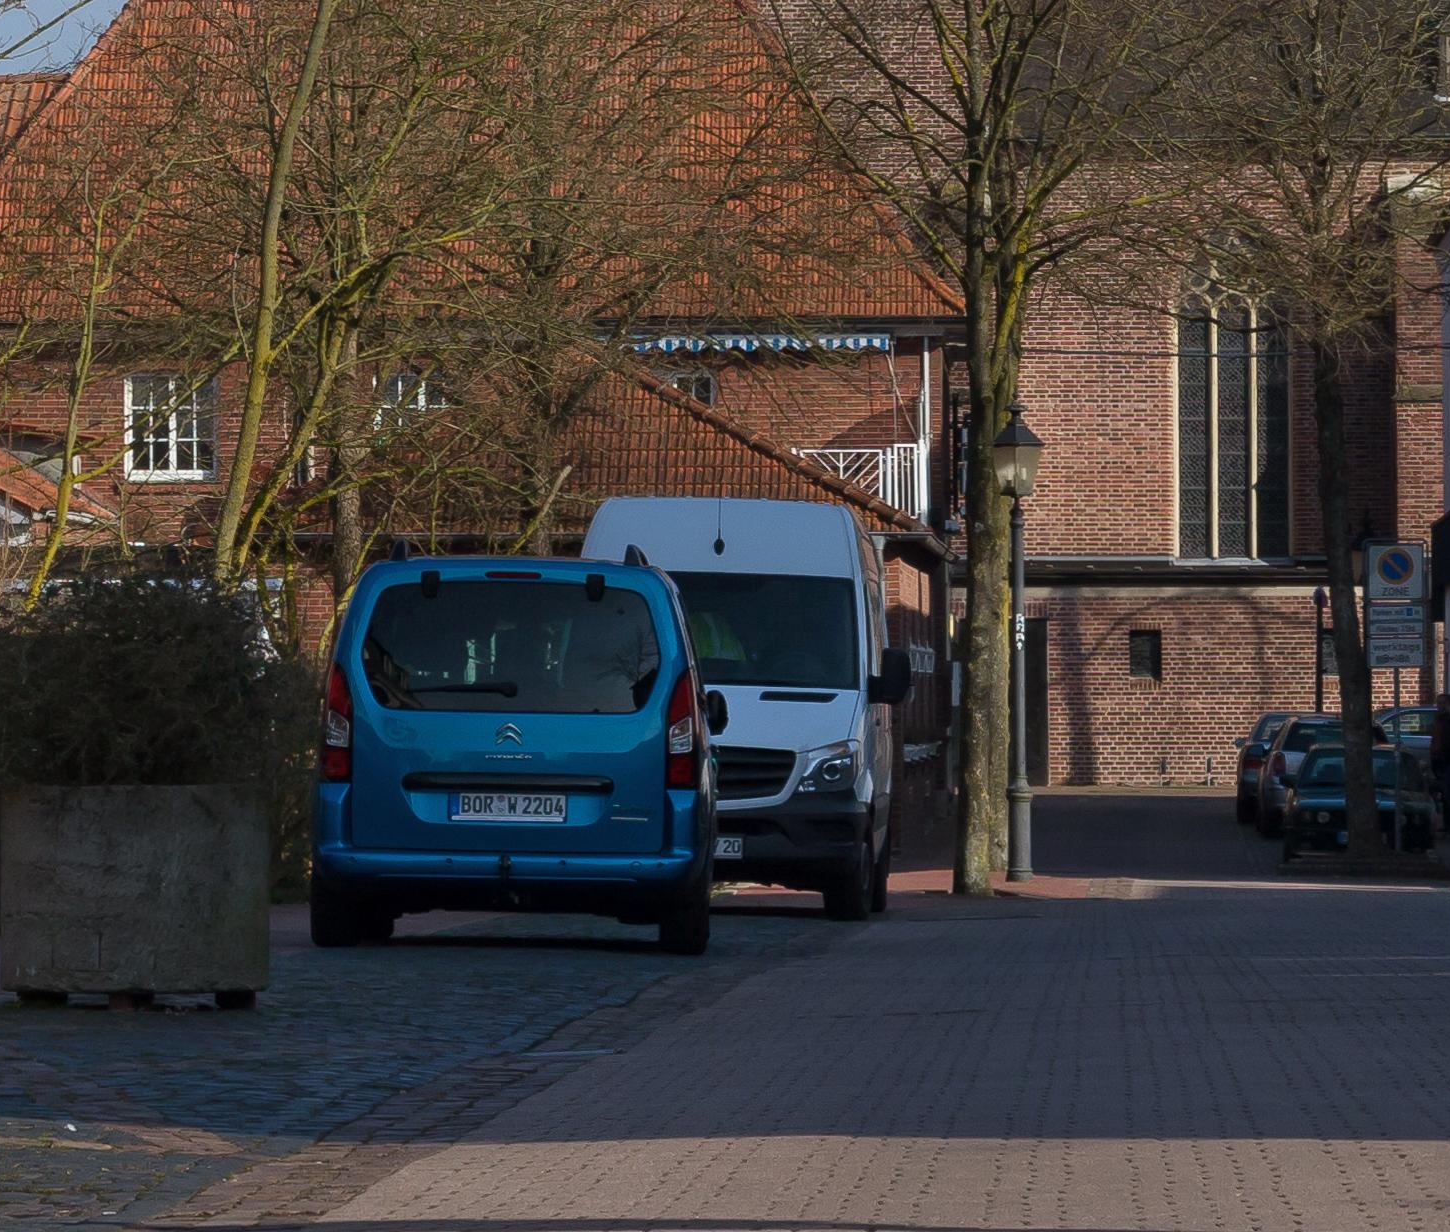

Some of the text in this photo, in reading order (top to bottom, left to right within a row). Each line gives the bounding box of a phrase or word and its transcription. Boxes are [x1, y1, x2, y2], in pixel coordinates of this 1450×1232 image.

[1381, 587, 1410, 597] ZONE
[460, 795, 564, 816] BOR W 2204
[723, 840, 741, 854] 20
